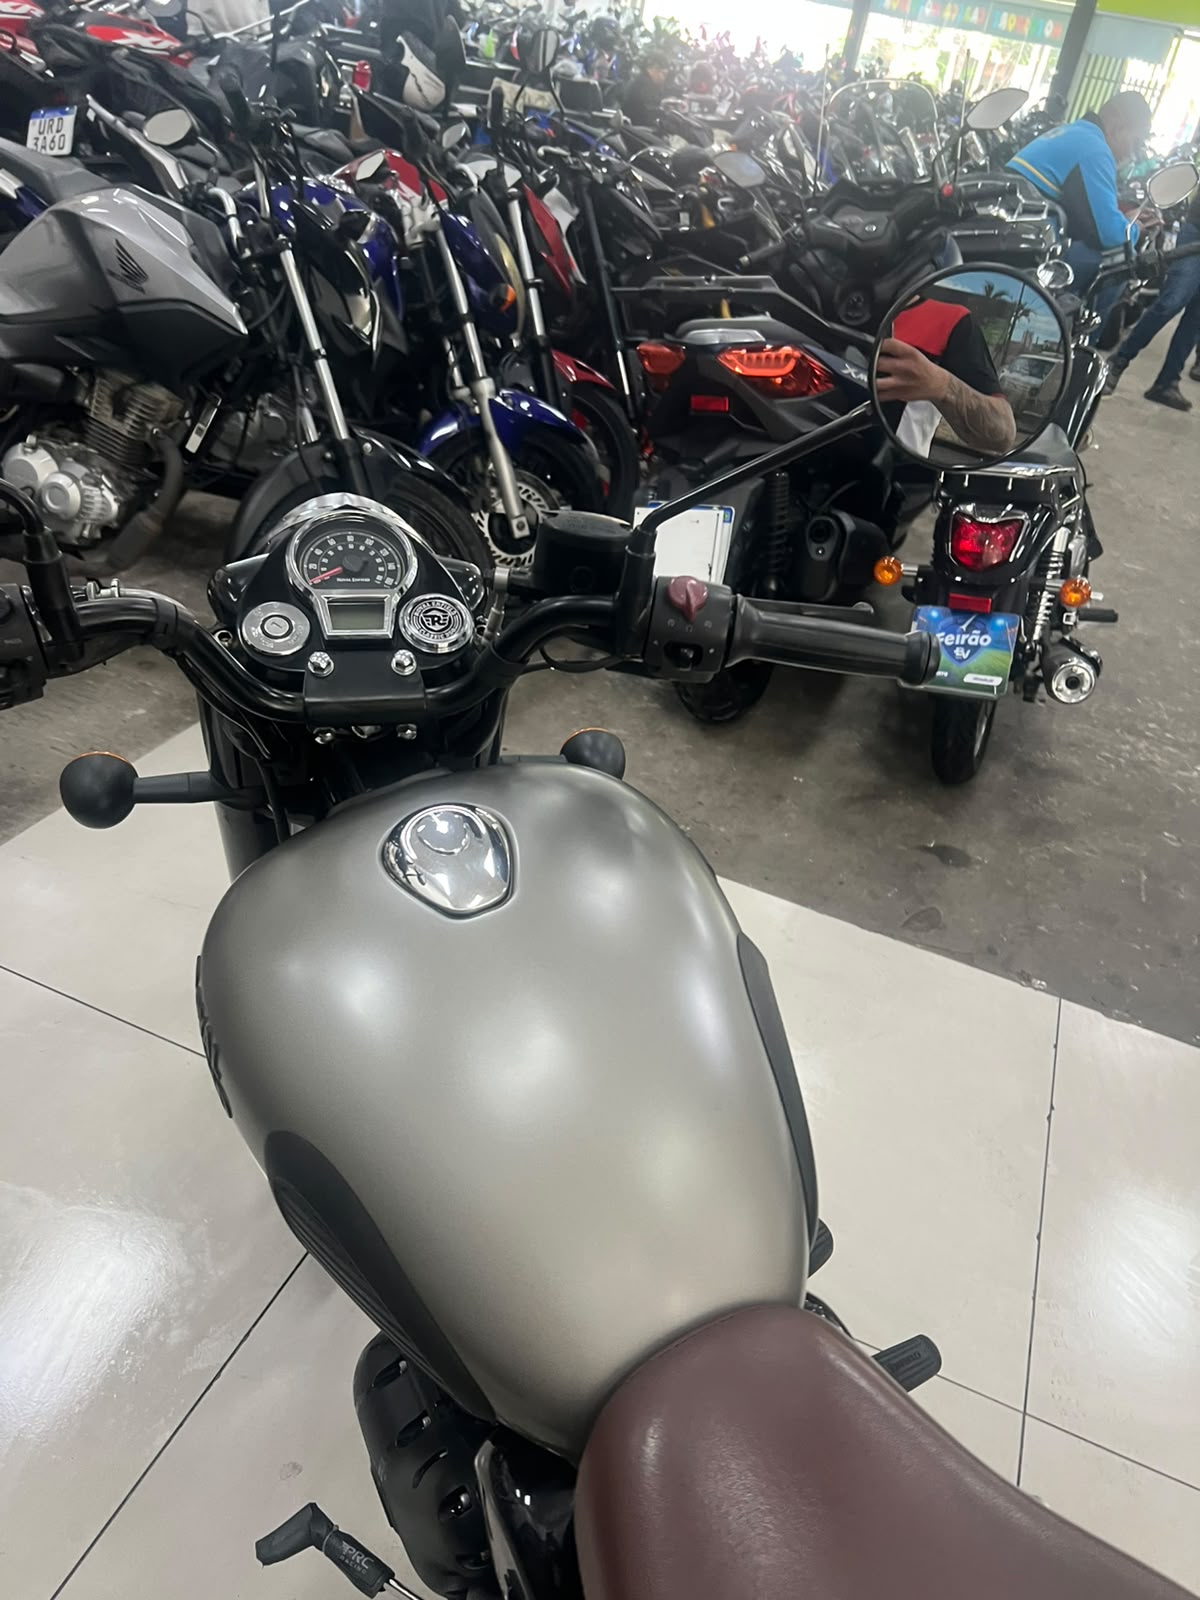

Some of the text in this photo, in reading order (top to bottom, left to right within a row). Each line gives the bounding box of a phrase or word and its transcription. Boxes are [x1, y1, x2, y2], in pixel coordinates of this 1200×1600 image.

[38, 116, 64, 135] URD
[33, 133, 66, 151] 3A60
[936, 630, 992, 647] Feirão
